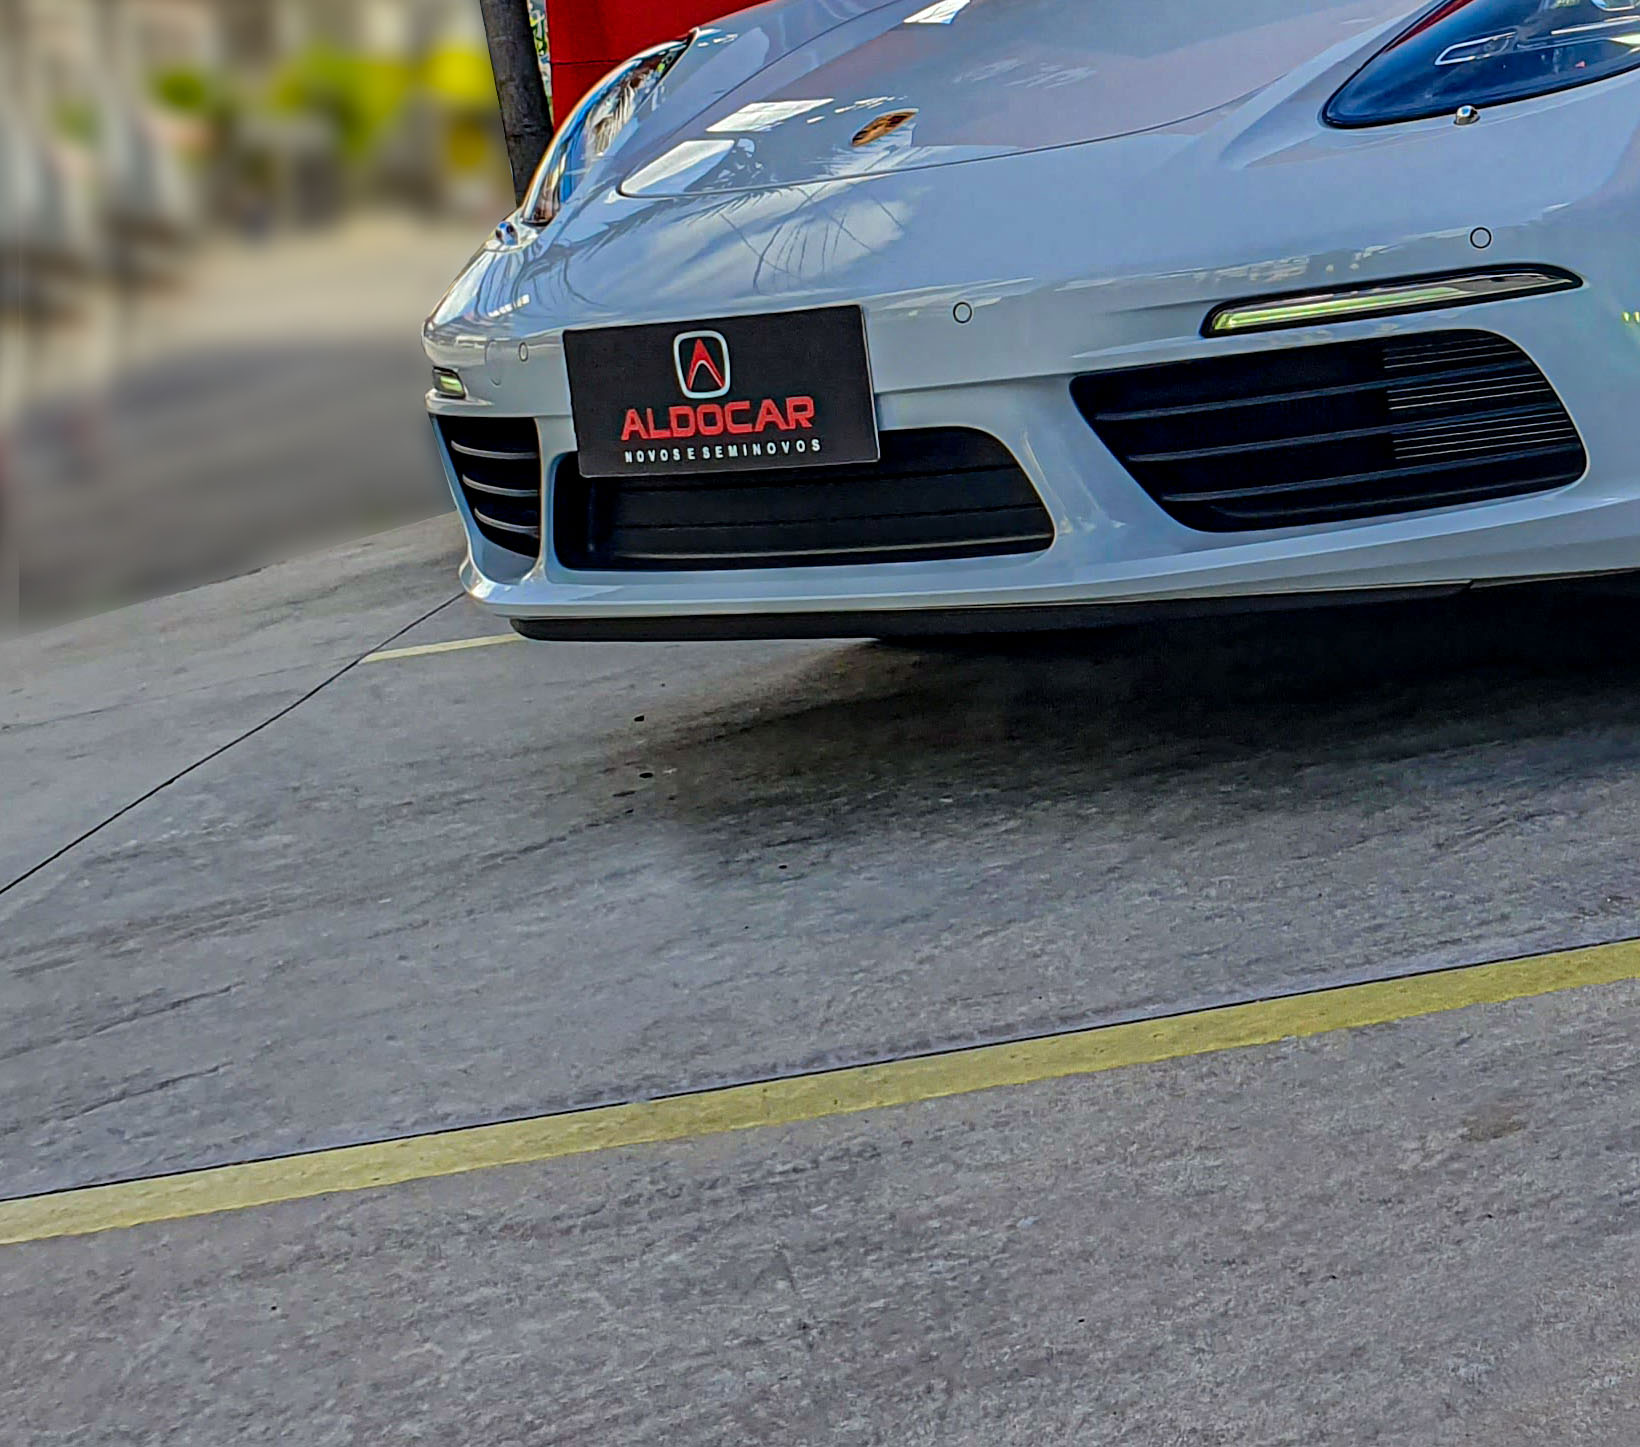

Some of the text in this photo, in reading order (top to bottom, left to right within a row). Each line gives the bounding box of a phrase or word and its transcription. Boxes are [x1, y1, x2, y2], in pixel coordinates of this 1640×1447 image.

[621, 396, 815, 441] ALDOCAR
[625, 438, 821, 463] NOVOS E SEMINOVOS
